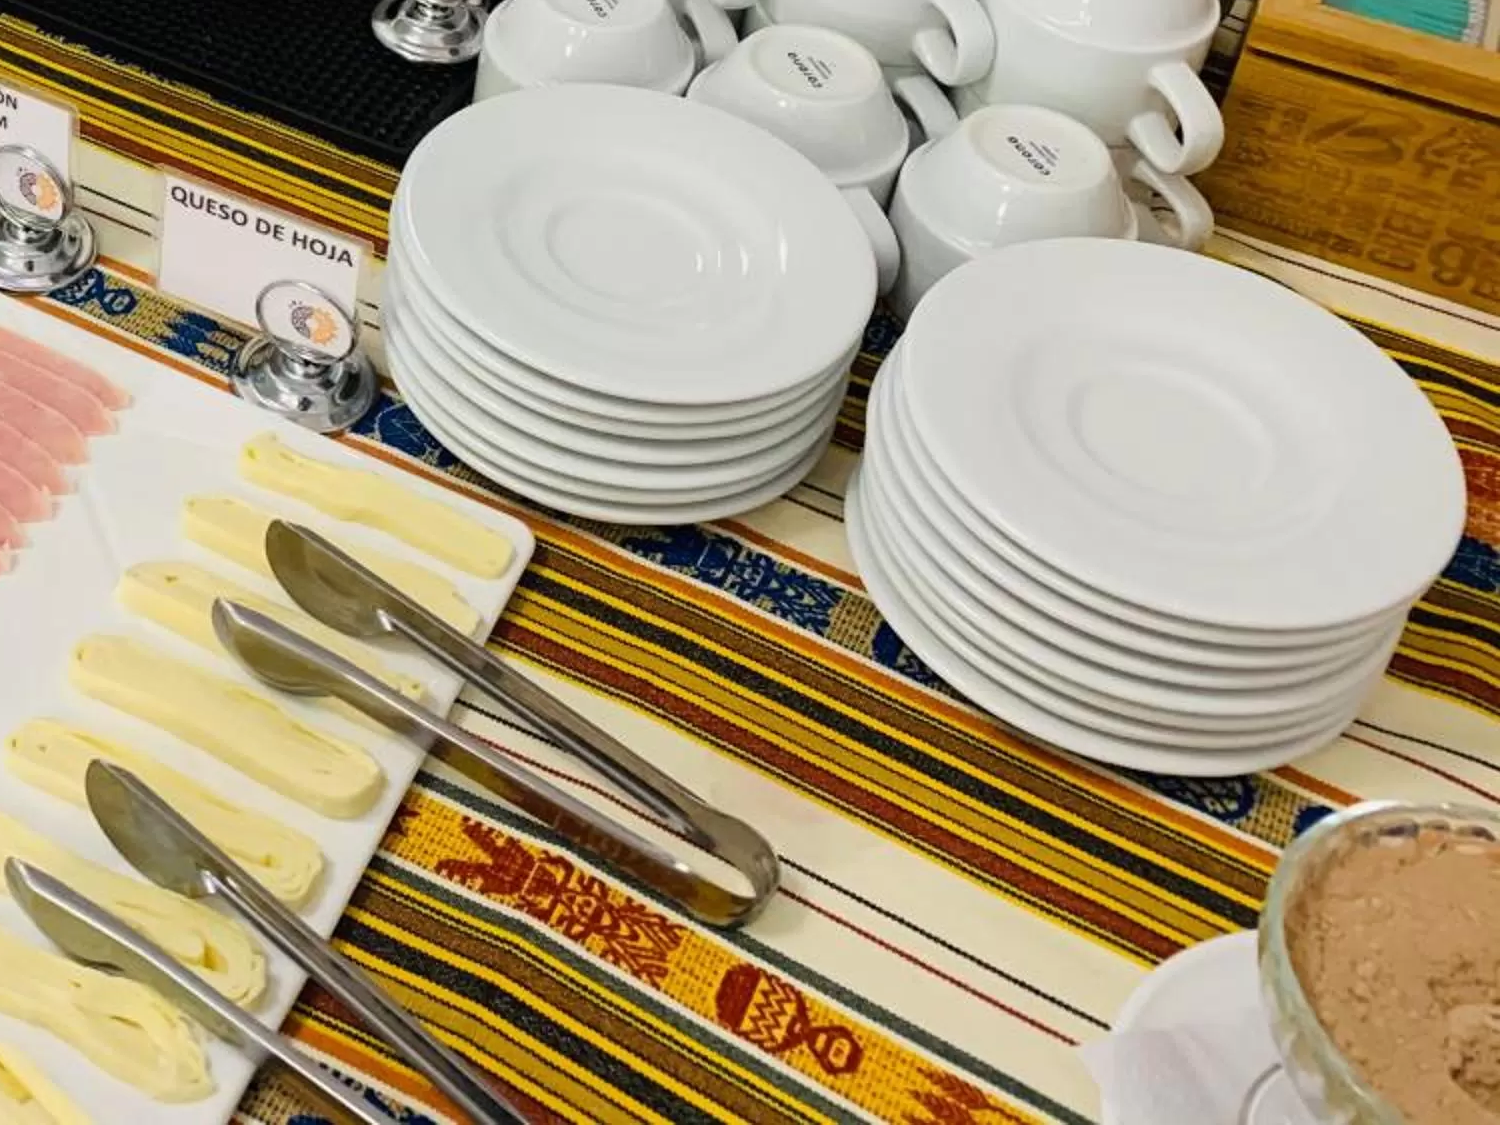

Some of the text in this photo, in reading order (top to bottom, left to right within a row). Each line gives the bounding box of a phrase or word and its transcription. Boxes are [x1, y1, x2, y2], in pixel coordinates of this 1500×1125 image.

[170, 185, 355, 268] QUESO DE HOJA
